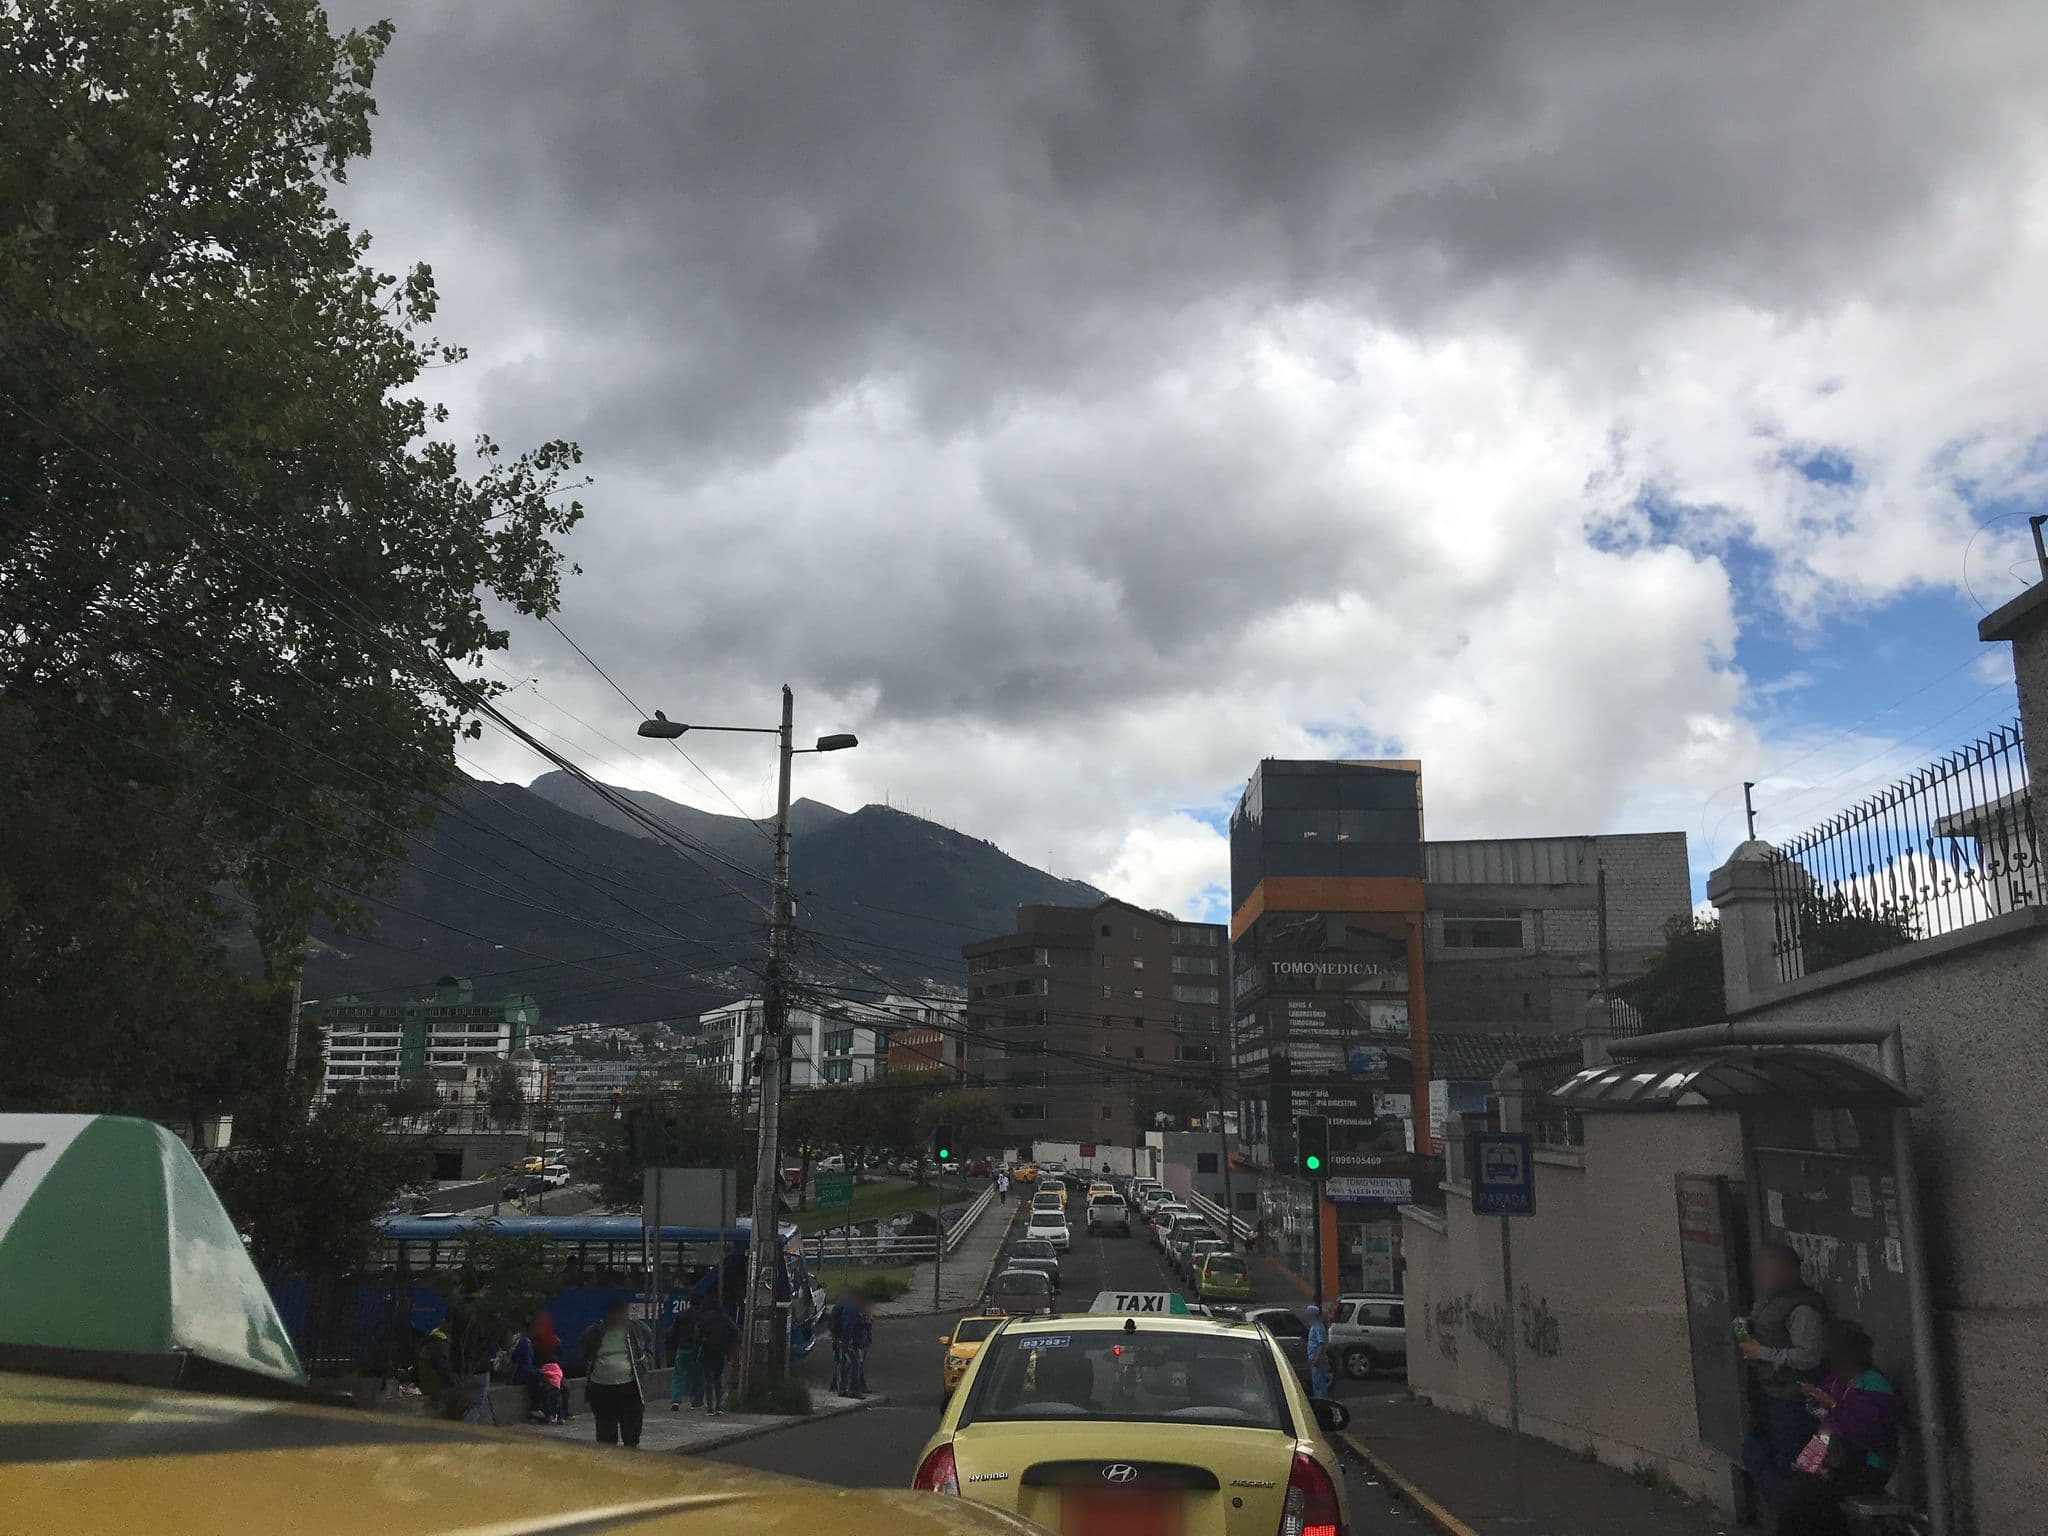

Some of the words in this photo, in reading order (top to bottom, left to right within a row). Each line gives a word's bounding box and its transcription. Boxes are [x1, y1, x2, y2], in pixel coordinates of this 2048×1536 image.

[1271, 961, 1381, 975] TOMOMEDICAL
[1479, 1192, 1528, 1207] PARADA
[1115, 1295, 1164, 1312] TAXI
